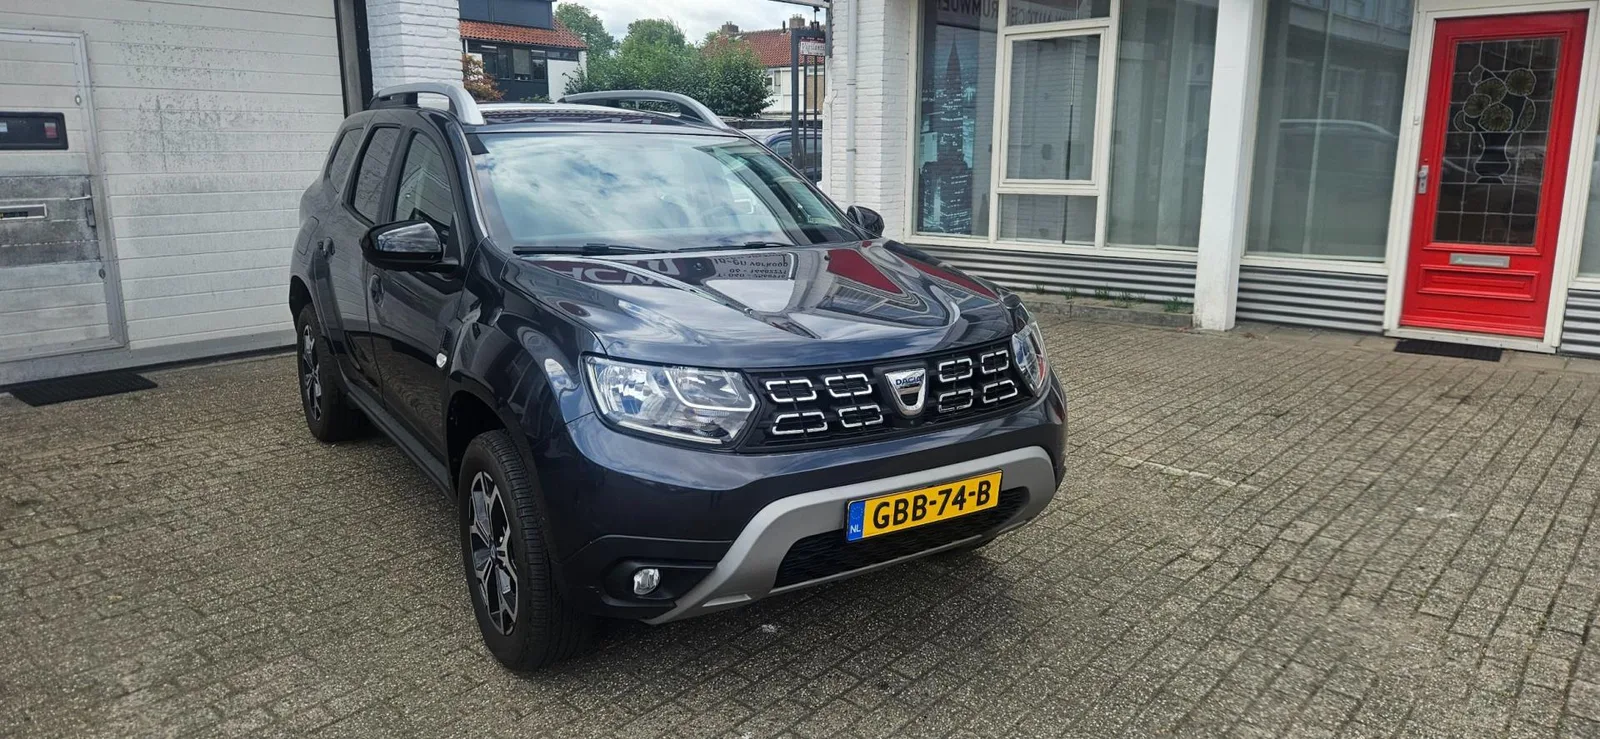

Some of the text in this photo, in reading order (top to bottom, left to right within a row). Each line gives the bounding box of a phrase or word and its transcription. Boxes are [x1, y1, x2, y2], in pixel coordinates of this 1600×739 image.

[896, 375, 922, 385] DACIA
[850, 480, 991, 533] NL GBB-74-B
